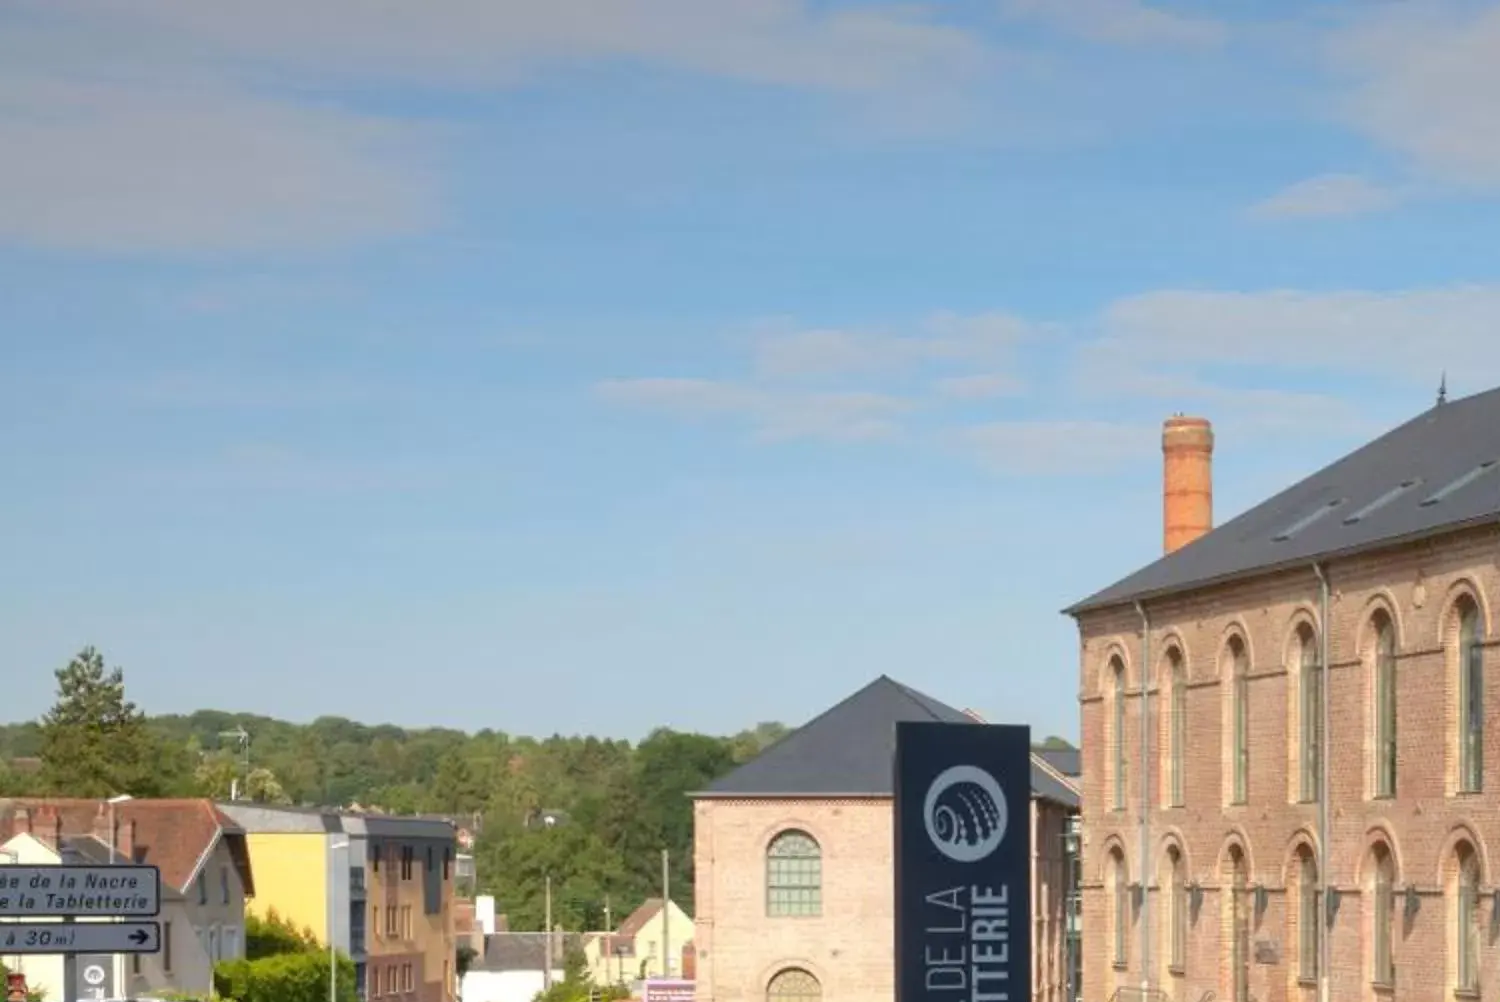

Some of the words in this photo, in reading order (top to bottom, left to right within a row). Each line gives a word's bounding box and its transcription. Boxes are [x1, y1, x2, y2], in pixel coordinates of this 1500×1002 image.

[29, 872, 51, 889] de
[60, 873, 76, 889] la
[85, 873, 138, 889] Nacre
[18, 891, 35, 909] la
[46, 893, 149, 909] Tabletterie
[924, 884, 967, 933] LA
[5, 930, 16, 946] à
[924, 945, 967, 991] DE
